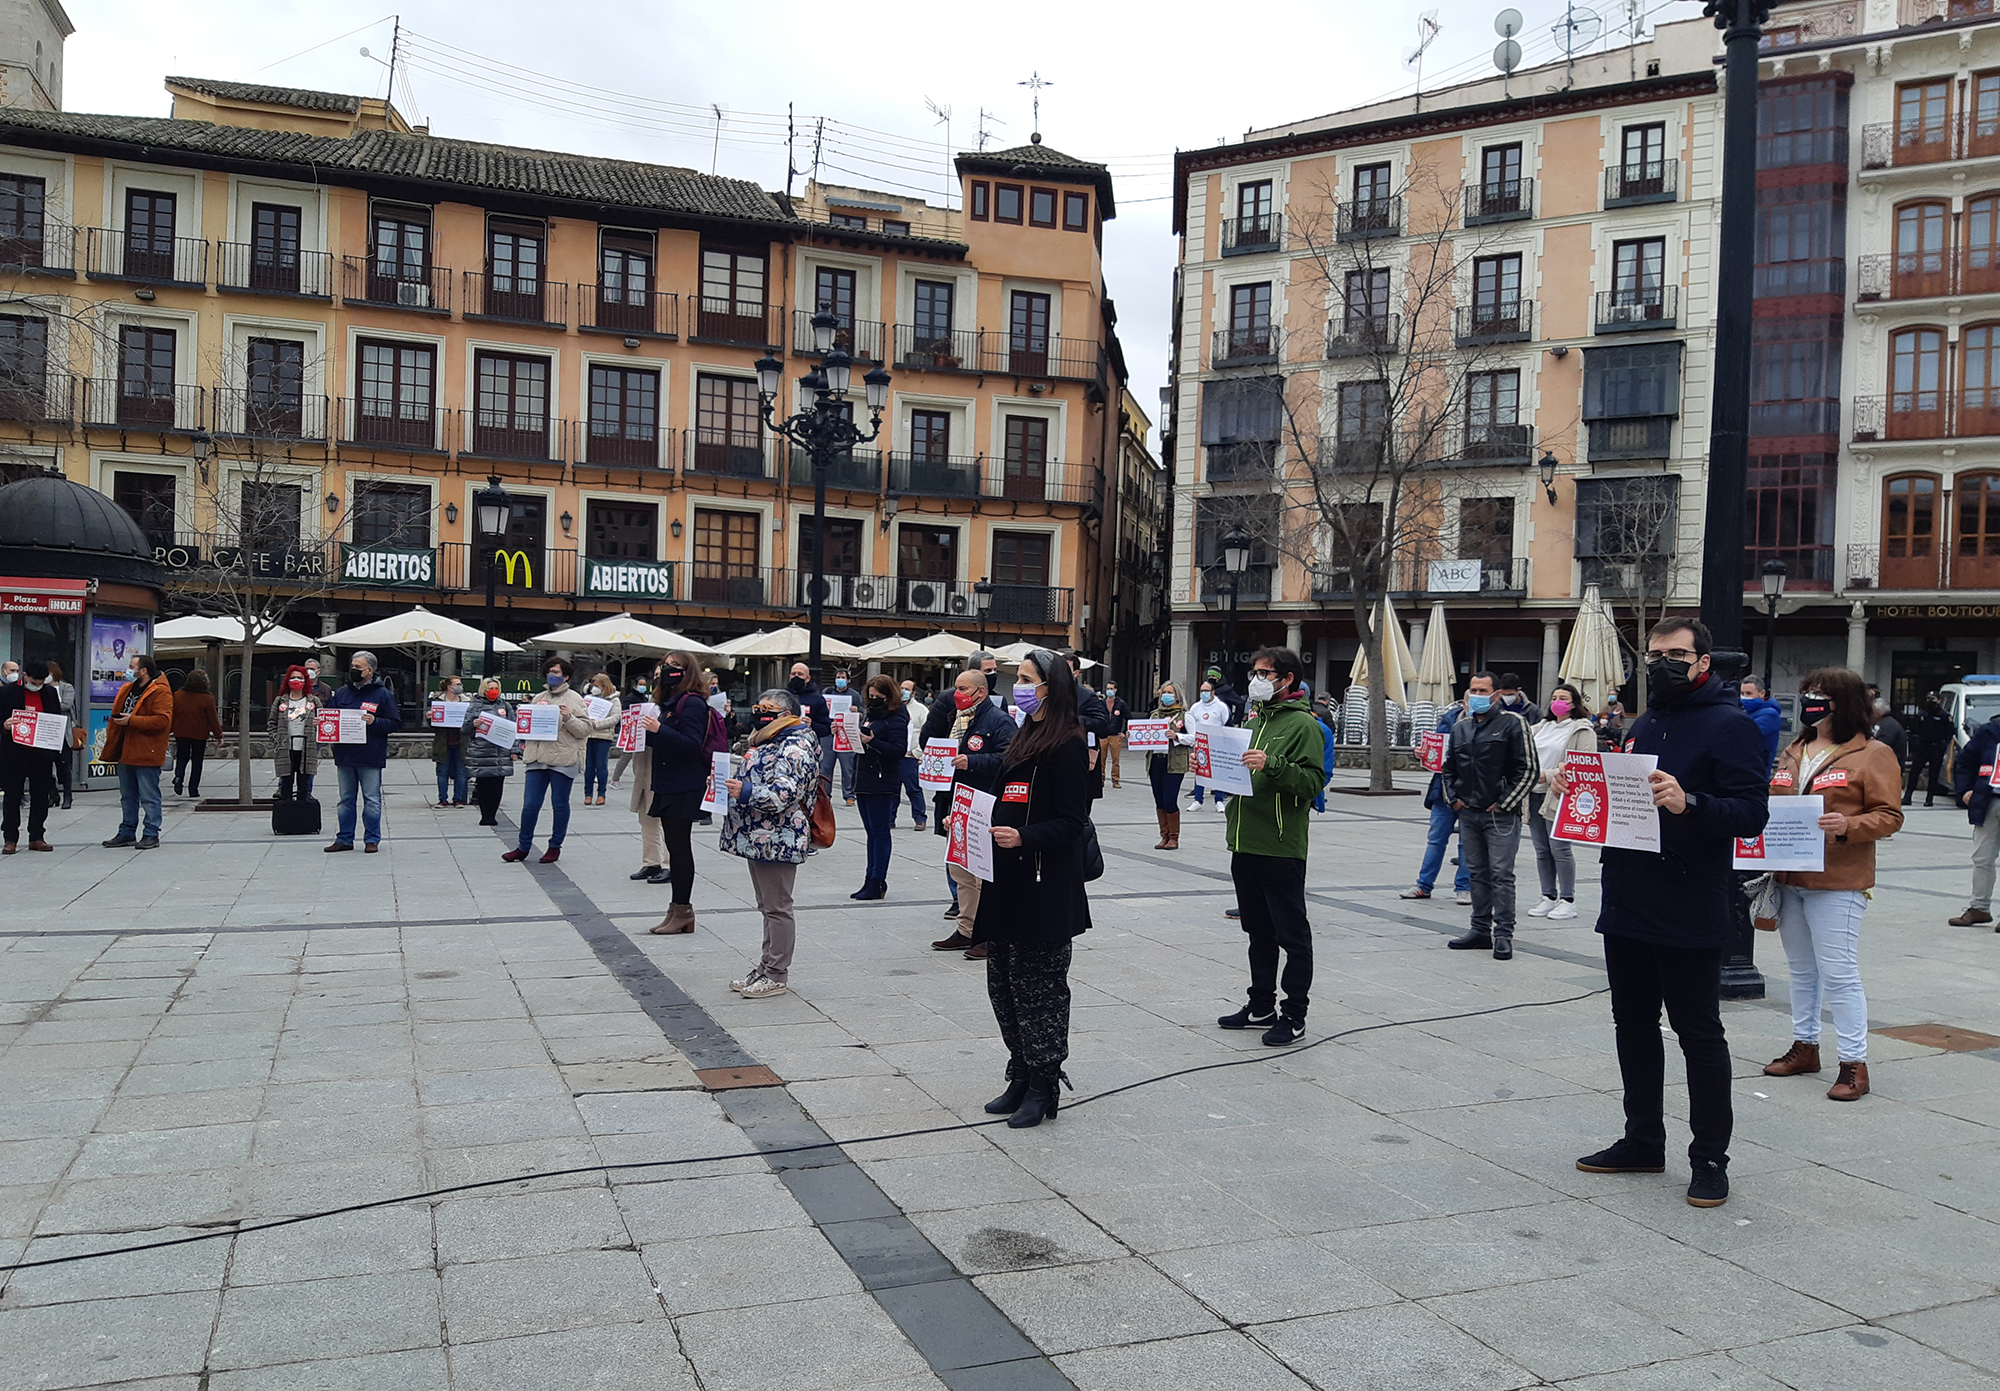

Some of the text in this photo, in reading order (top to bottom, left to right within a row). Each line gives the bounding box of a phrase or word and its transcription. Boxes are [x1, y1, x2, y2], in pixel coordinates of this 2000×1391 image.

[284, 554, 322, 574] BAR
[344, 551, 431, 582] ABIERTOS
[1438, 568, 1471, 580] ABC
[590, 566, 668, 594] ABIERTOS
[14, 596, 37, 604] Plaza
[50, 600, 80, 610] ¡HOLA!
[3, 603, 47, 612] Zocodover
[1878, 606, 1922, 617] HOTEL
[91, 765, 105, 776] YO
[1566, 766, 1604, 782] SÍ TOCA!
[1814, 772, 1846, 785] CCOO
[1004, 785, 1027, 794] CCOO
